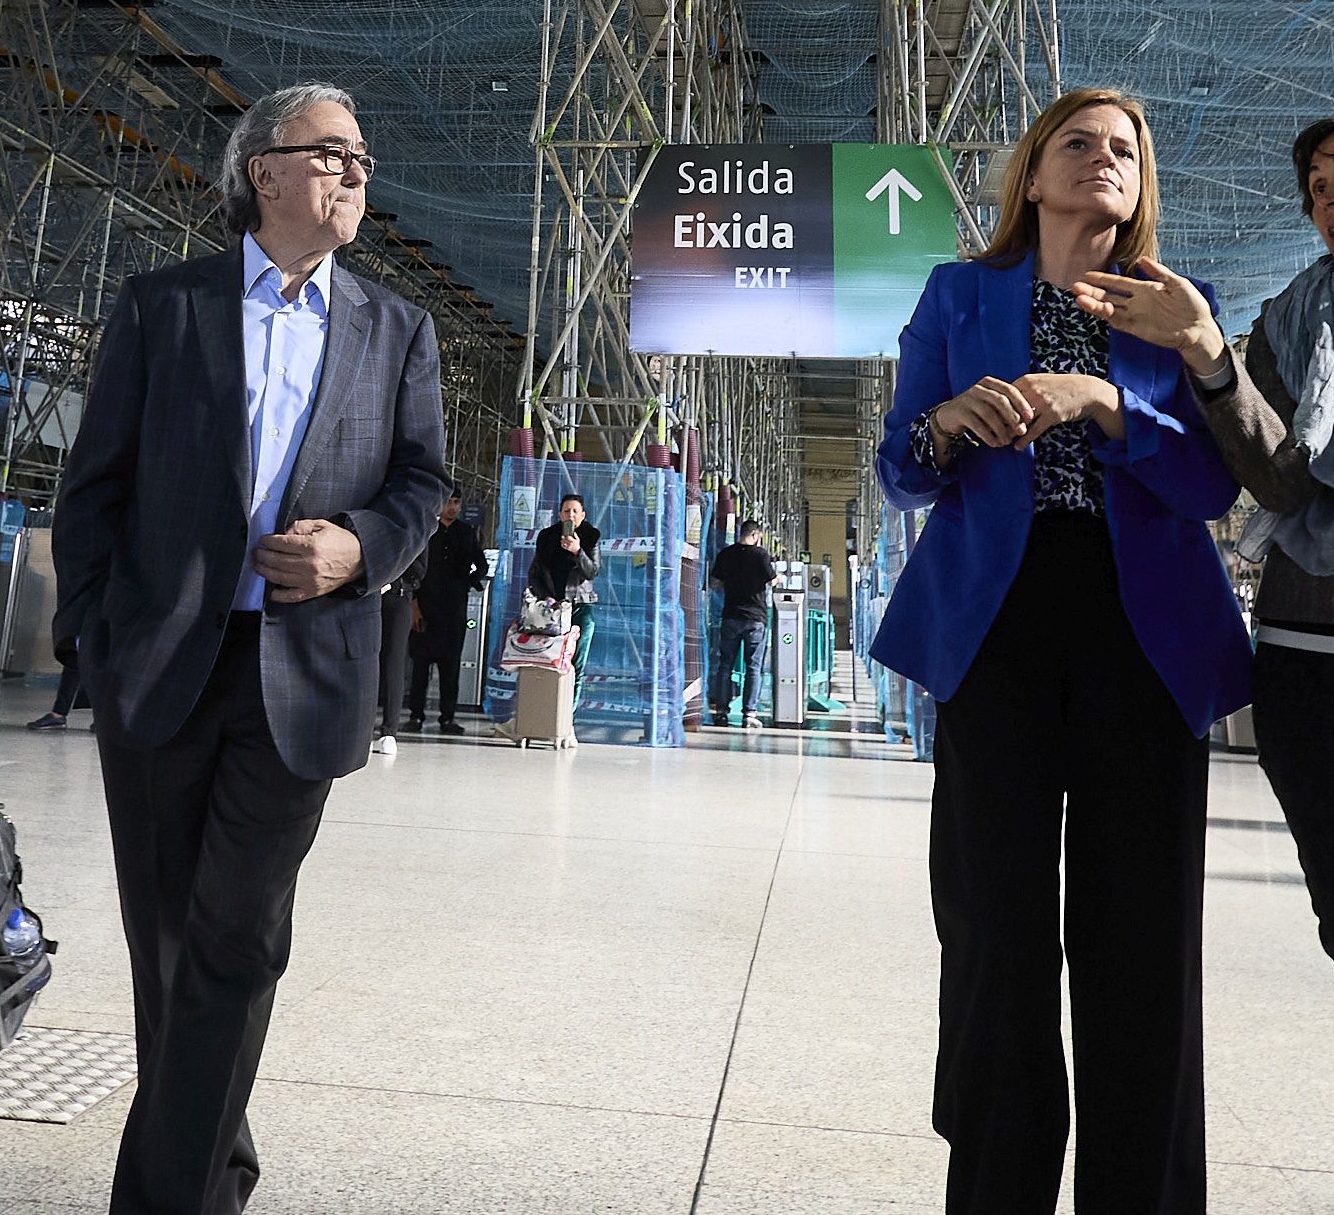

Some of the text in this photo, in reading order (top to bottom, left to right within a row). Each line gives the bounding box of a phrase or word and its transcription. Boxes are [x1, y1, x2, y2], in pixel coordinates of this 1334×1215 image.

[677, 160, 794, 195] Salida
[674, 212, 794, 249] Eixida
[734, 267, 791, 289] EXIT
